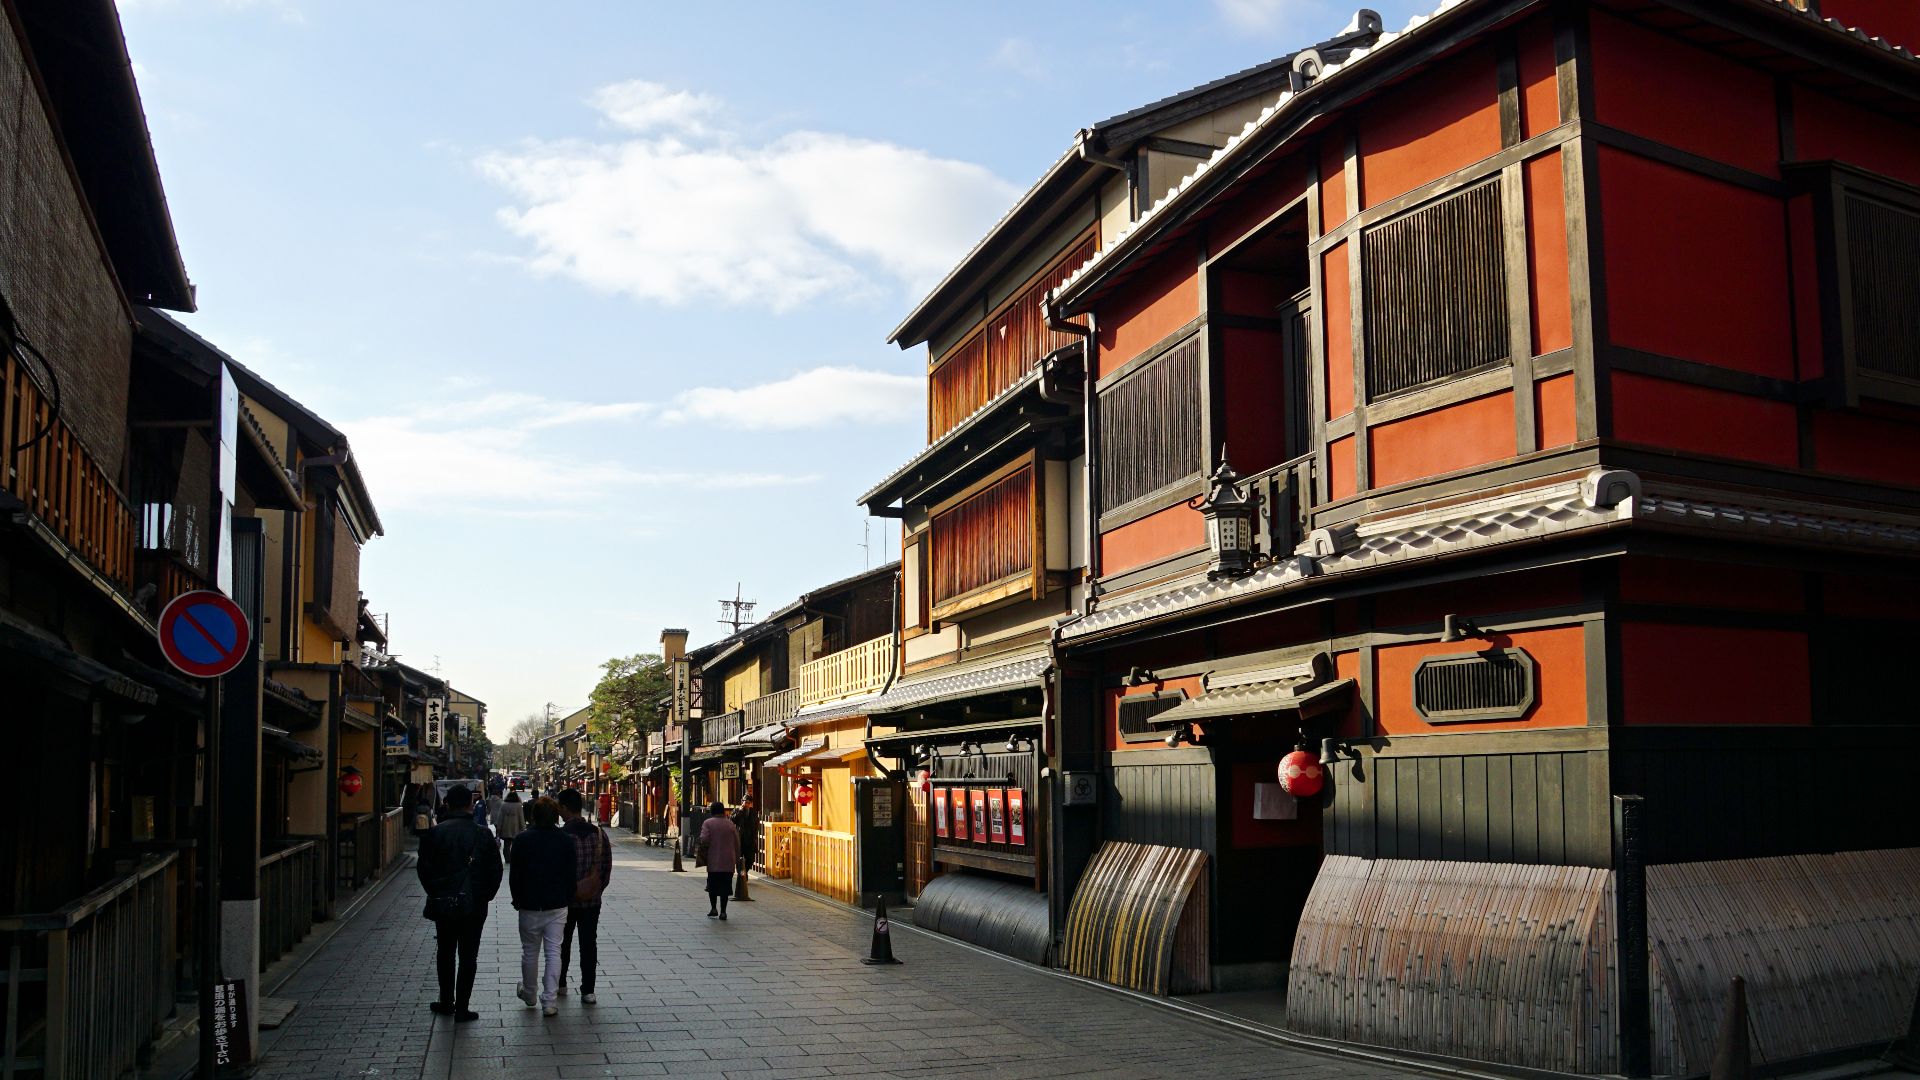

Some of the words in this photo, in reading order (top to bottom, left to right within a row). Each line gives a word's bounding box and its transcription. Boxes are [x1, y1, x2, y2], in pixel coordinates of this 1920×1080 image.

[227, 983, 238, 1029] 車が通ります
